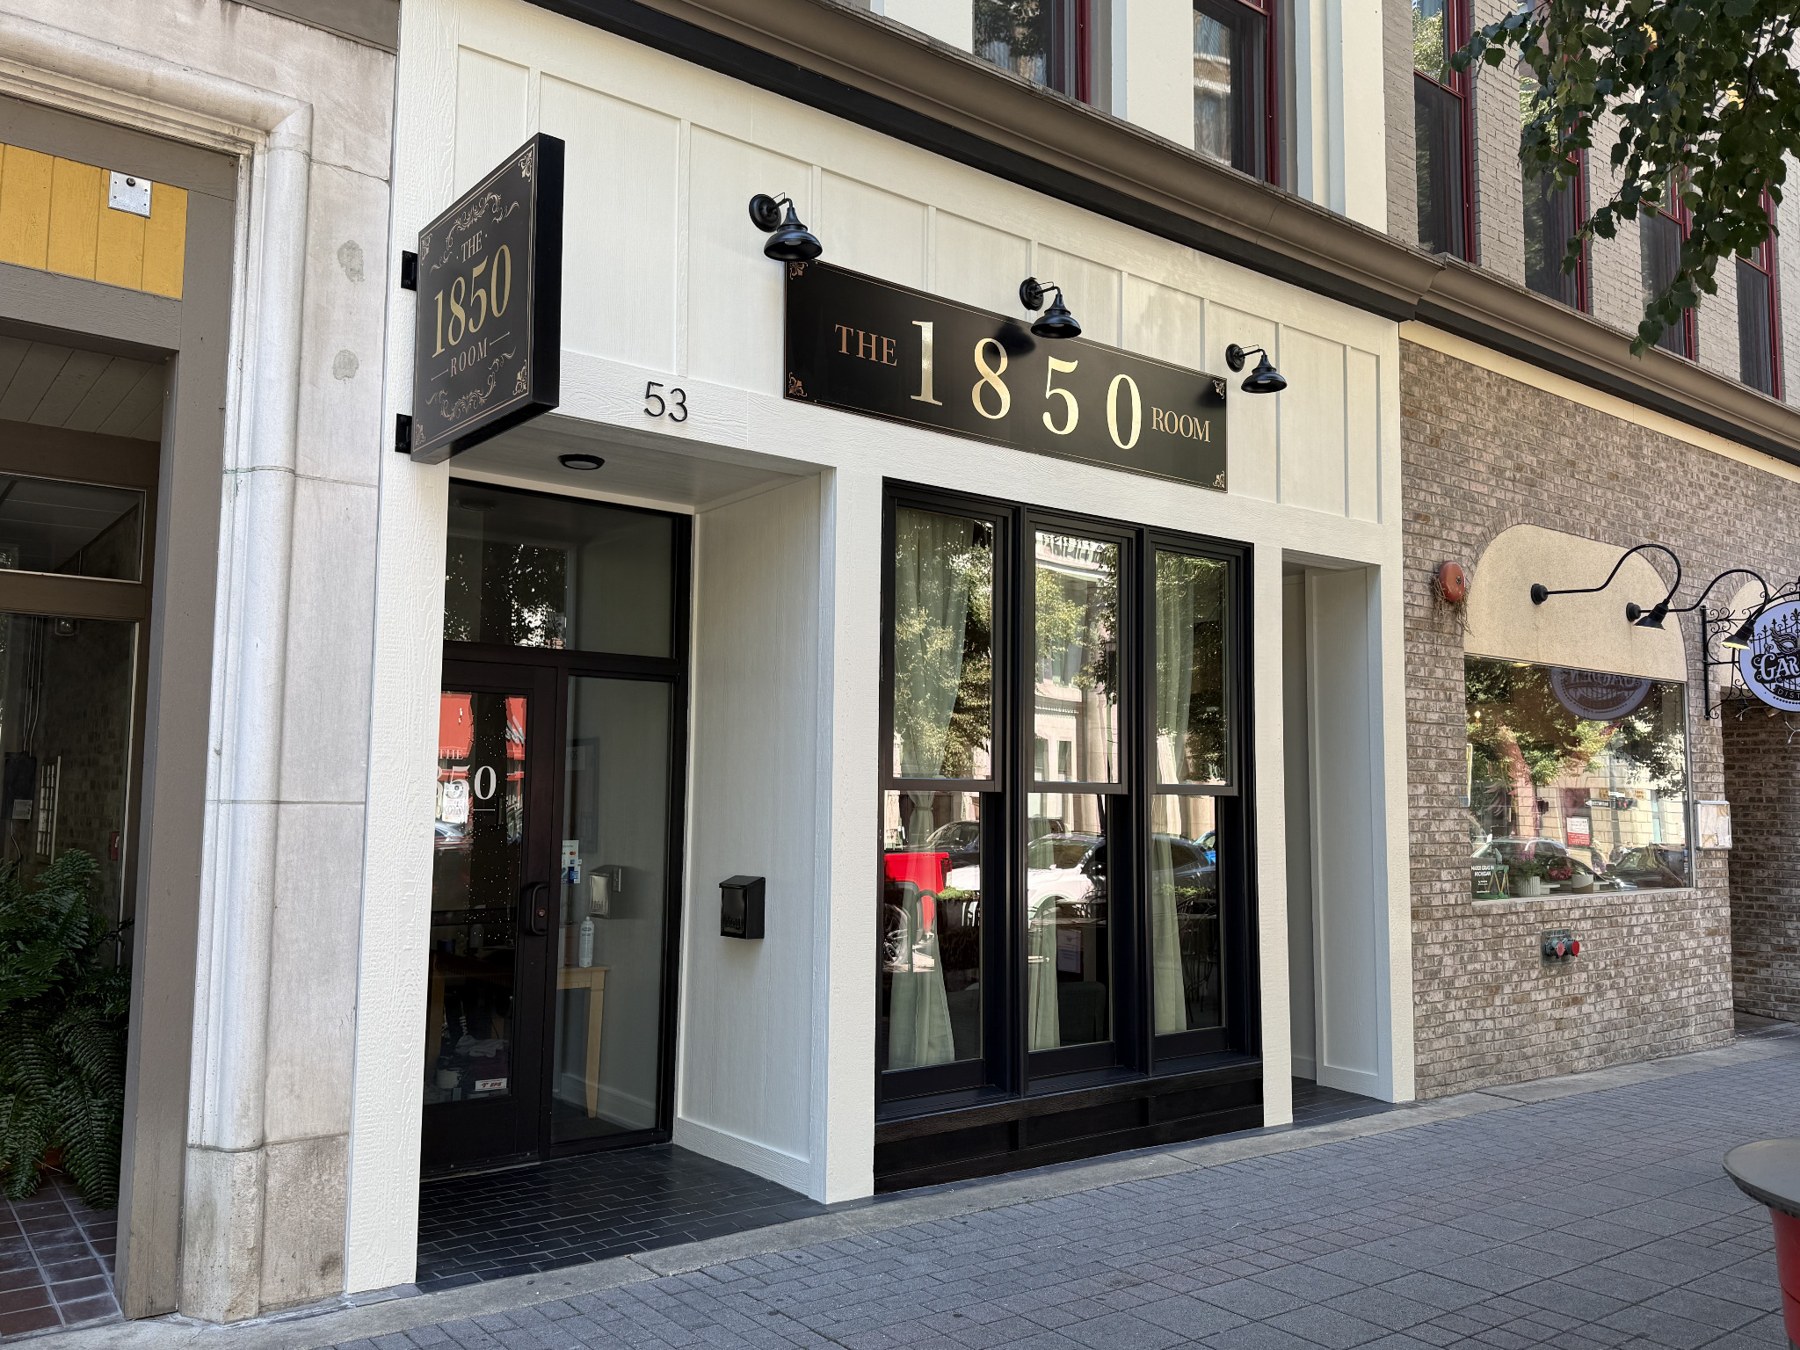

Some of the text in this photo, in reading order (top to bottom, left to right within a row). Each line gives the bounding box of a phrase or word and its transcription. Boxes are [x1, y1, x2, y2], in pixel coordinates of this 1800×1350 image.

[461, 230, 482, 263] THE
[432, 244, 511, 358] 1850
[451, 337, 487, 377] ROOM
[643, 381, 688, 422] 53
[835, 324, 898, 366] THE
[1151, 406, 1211, 443] ROOM
[1760, 653, 1800, 681] GAR
[1777, 688, 1800, 699] DIST
[436, 765, 497, 800] 50
